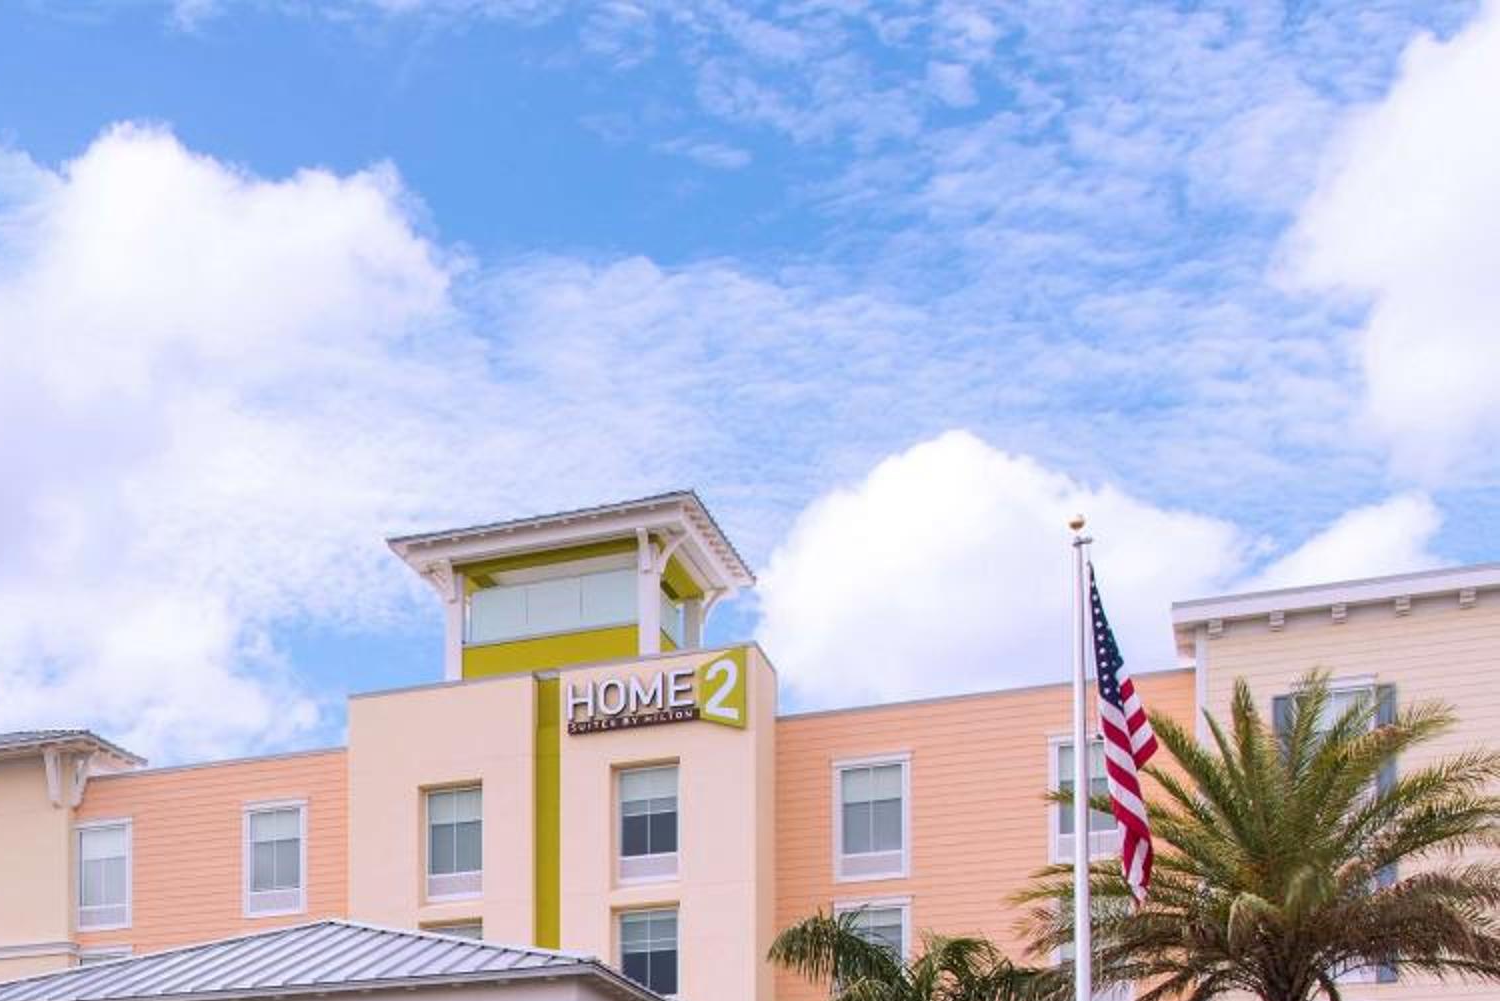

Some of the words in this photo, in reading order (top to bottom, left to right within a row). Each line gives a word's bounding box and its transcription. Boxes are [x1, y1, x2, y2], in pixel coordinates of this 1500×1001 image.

[567, 670, 695, 720] HOME
[706, 660, 739, 719] 2
[624, 716, 638, 726] BY
[645, 710, 693, 724] HILTON
